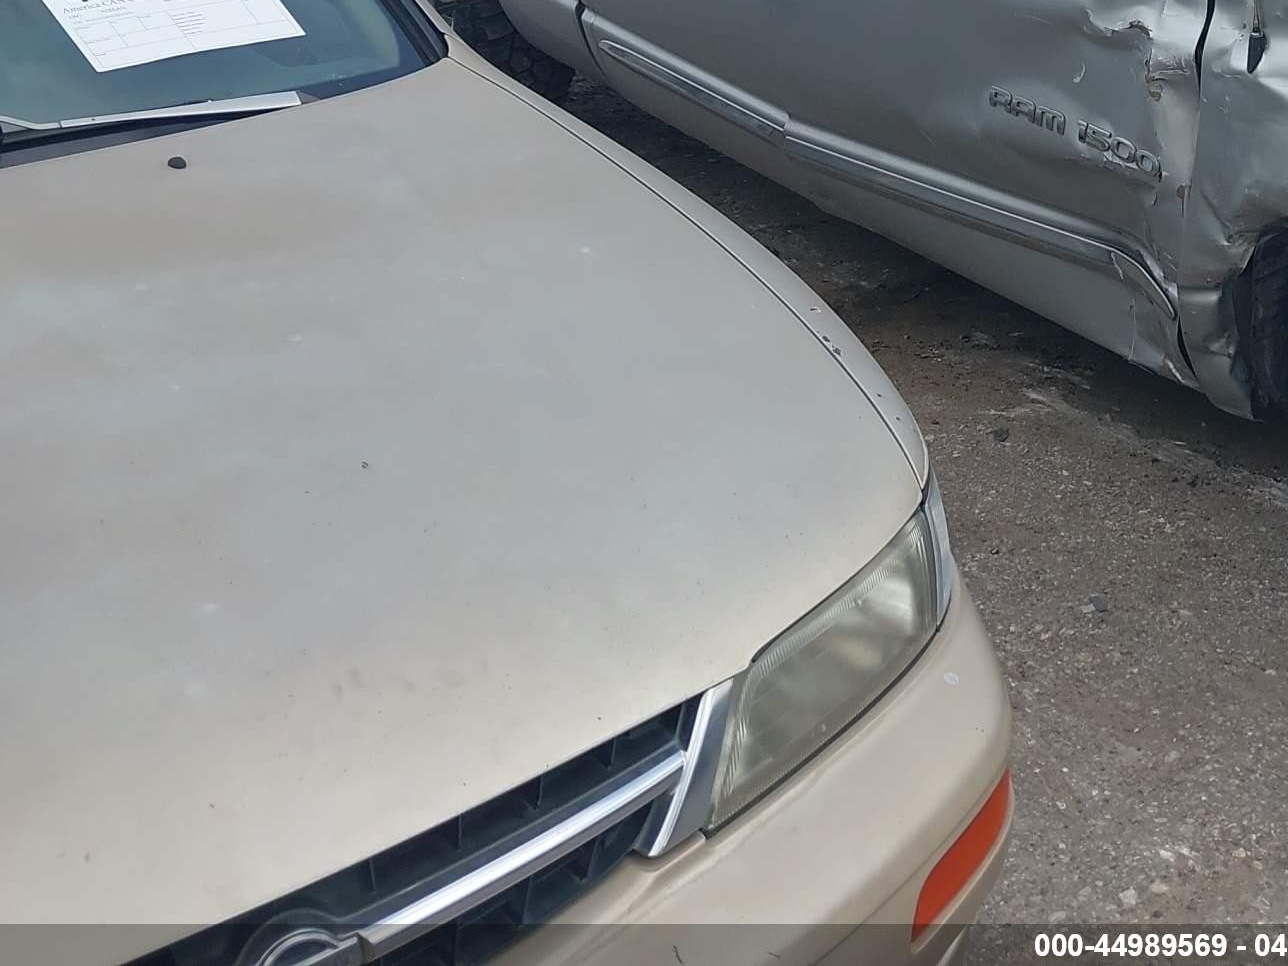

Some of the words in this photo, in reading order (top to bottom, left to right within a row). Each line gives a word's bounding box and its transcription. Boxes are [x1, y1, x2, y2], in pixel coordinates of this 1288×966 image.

[63, 1, 101, 14] America
[989, 85, 1066, 135] RAM
[1077, 119, 1162, 182] 1500
